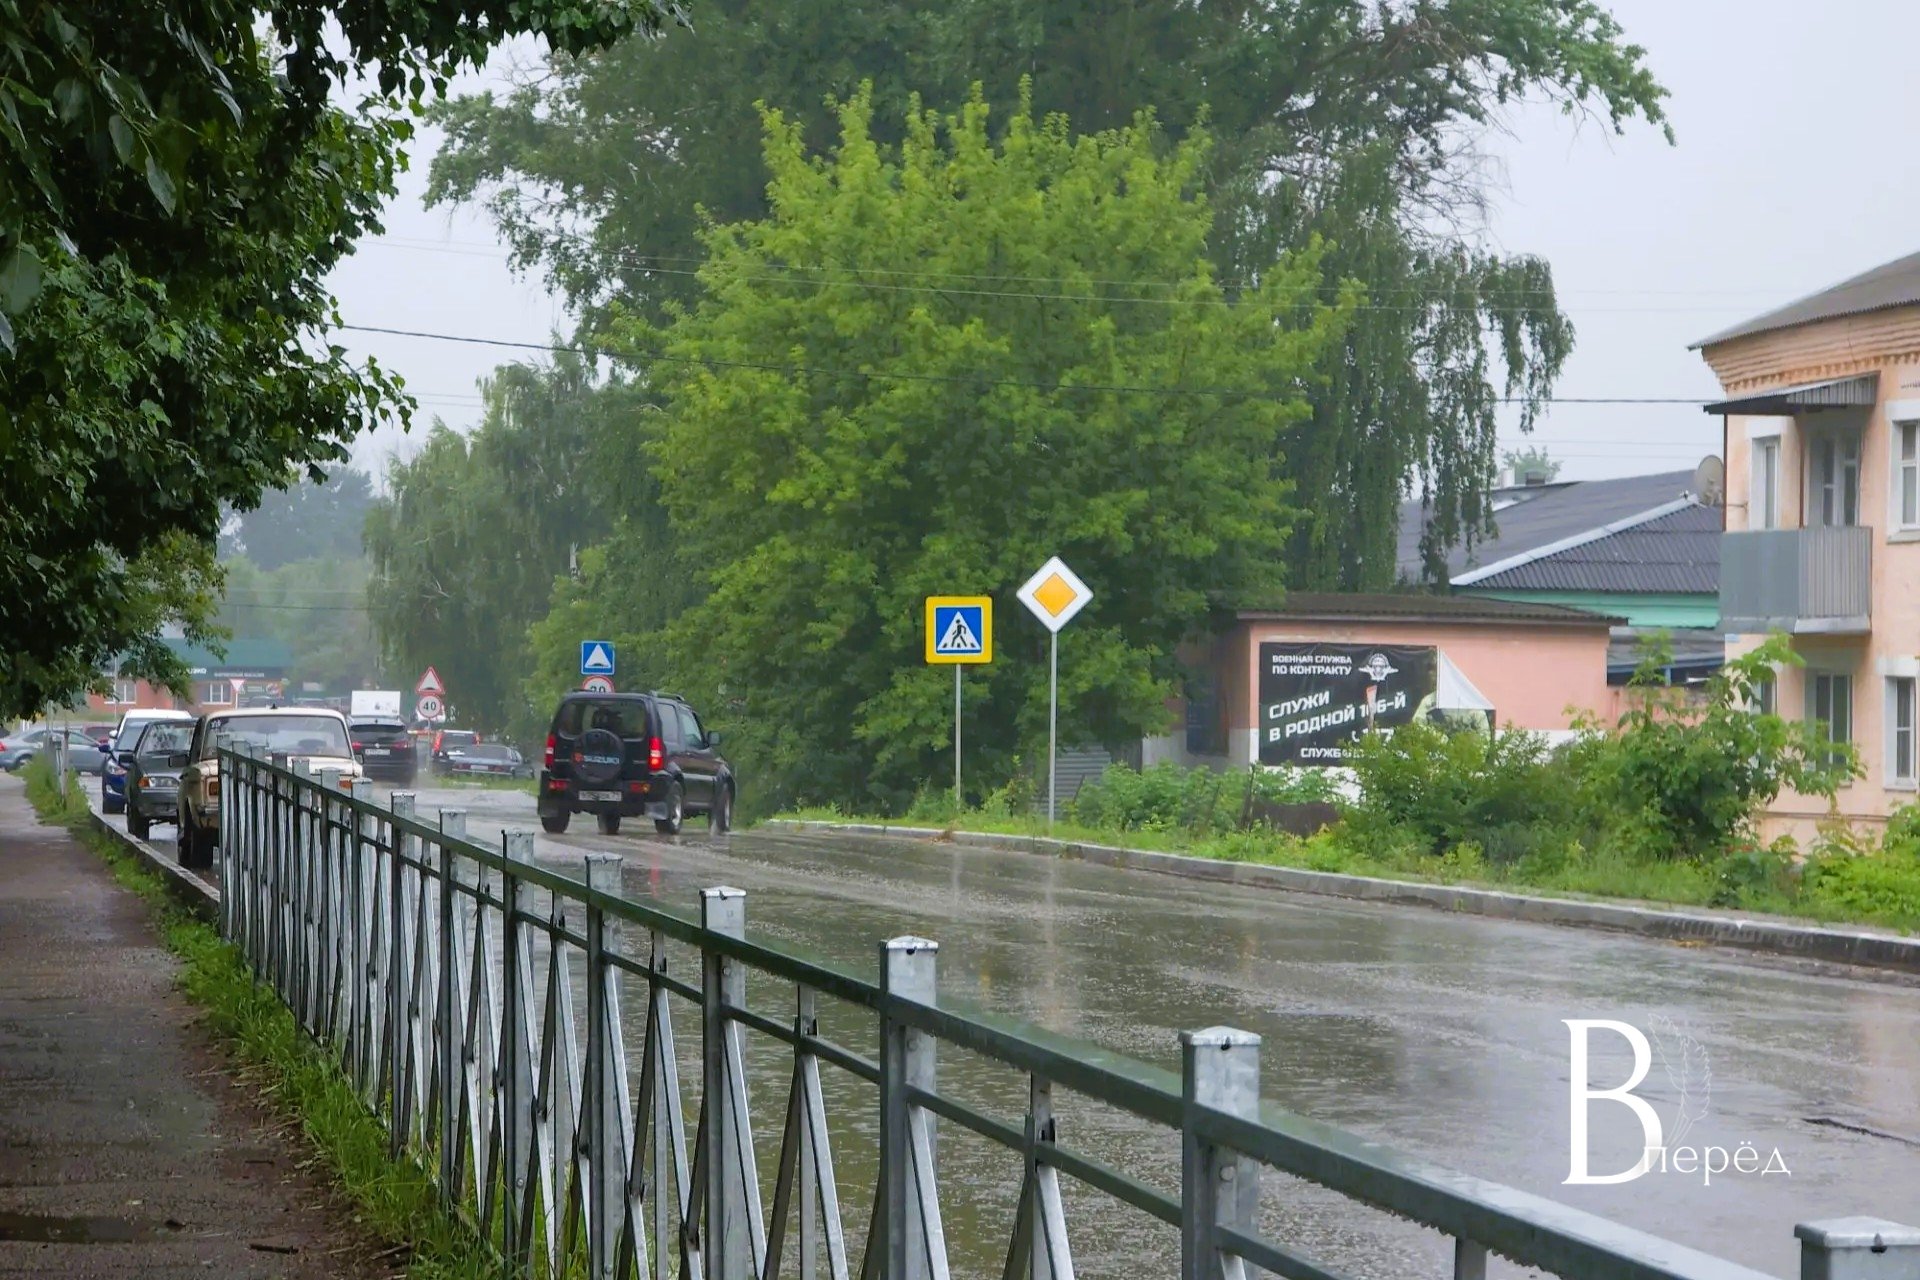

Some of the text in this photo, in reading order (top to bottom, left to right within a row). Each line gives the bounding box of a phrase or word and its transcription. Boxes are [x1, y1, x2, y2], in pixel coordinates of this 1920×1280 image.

[1272, 655, 1352, 664] ВОЕННАЯ СЛУЖБА
[1272, 665, 1352, 675] ПО КОНТРАКТУ
[423, 701, 437, 711] 40
[1269, 690, 1330, 719] СЛУЖИ
[1269, 727, 1281, 742] В
[1285, 705, 1355, 738] РОДНОЙ
